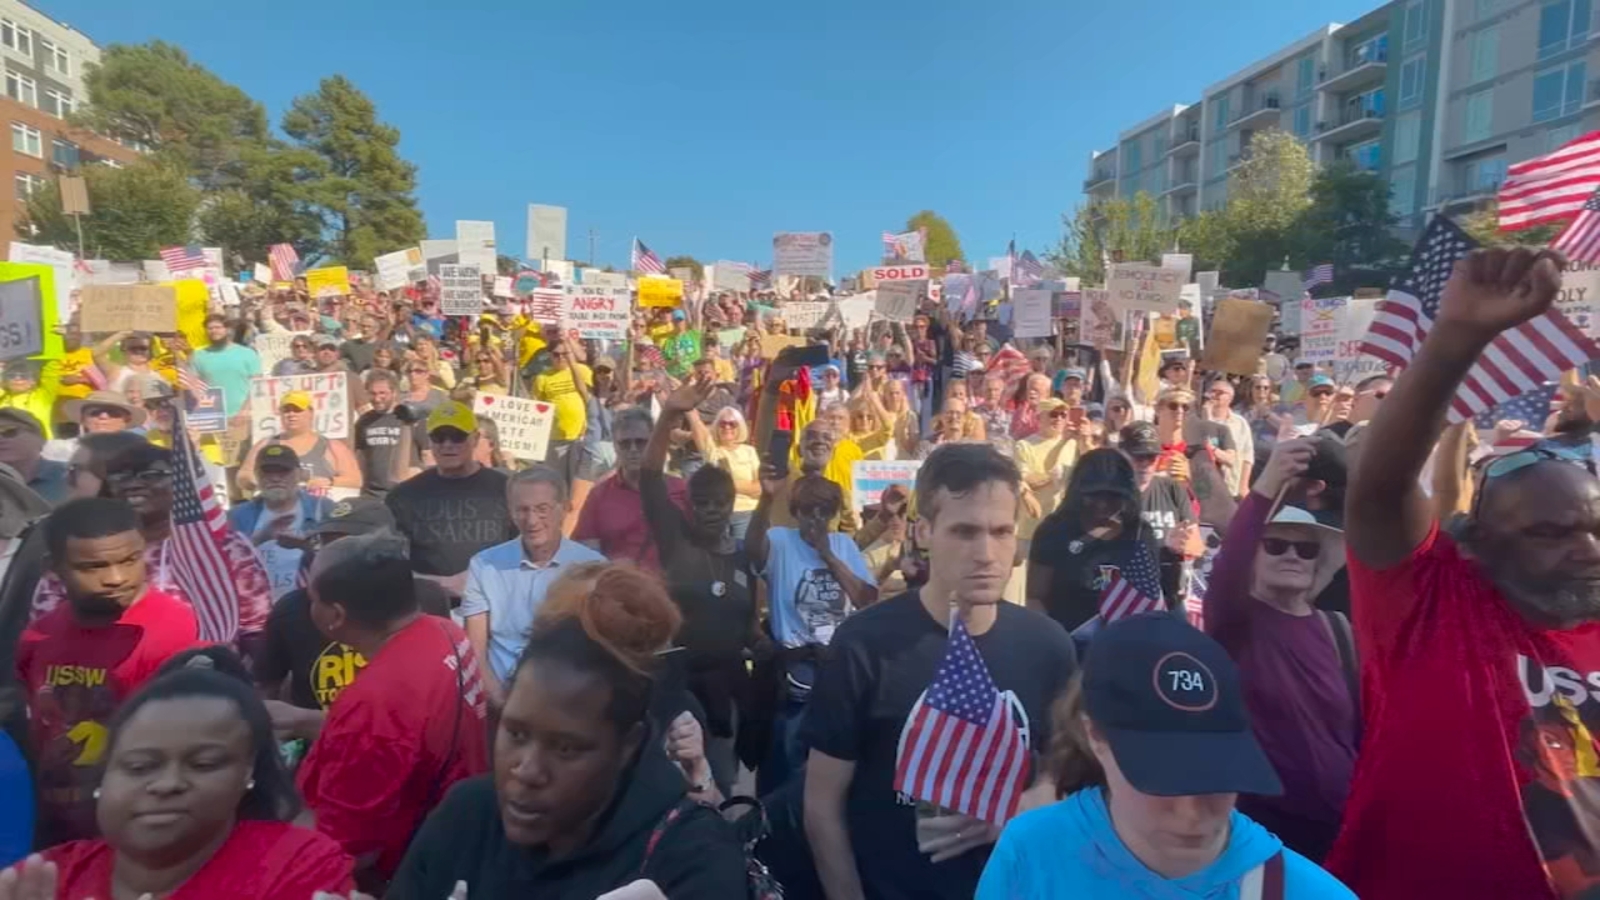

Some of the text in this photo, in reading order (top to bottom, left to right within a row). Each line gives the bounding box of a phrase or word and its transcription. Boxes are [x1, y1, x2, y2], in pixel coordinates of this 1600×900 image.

[874, 268, 925, 280] SOLD
[1555, 287, 1587, 302] OLY
[572, 297, 615, 311] ANGRY
[500, 399, 530, 412] LOVE
[315, 411, 344, 434] US
[500, 438, 537, 450] CISM!
[45, 664, 107, 688] USSW
